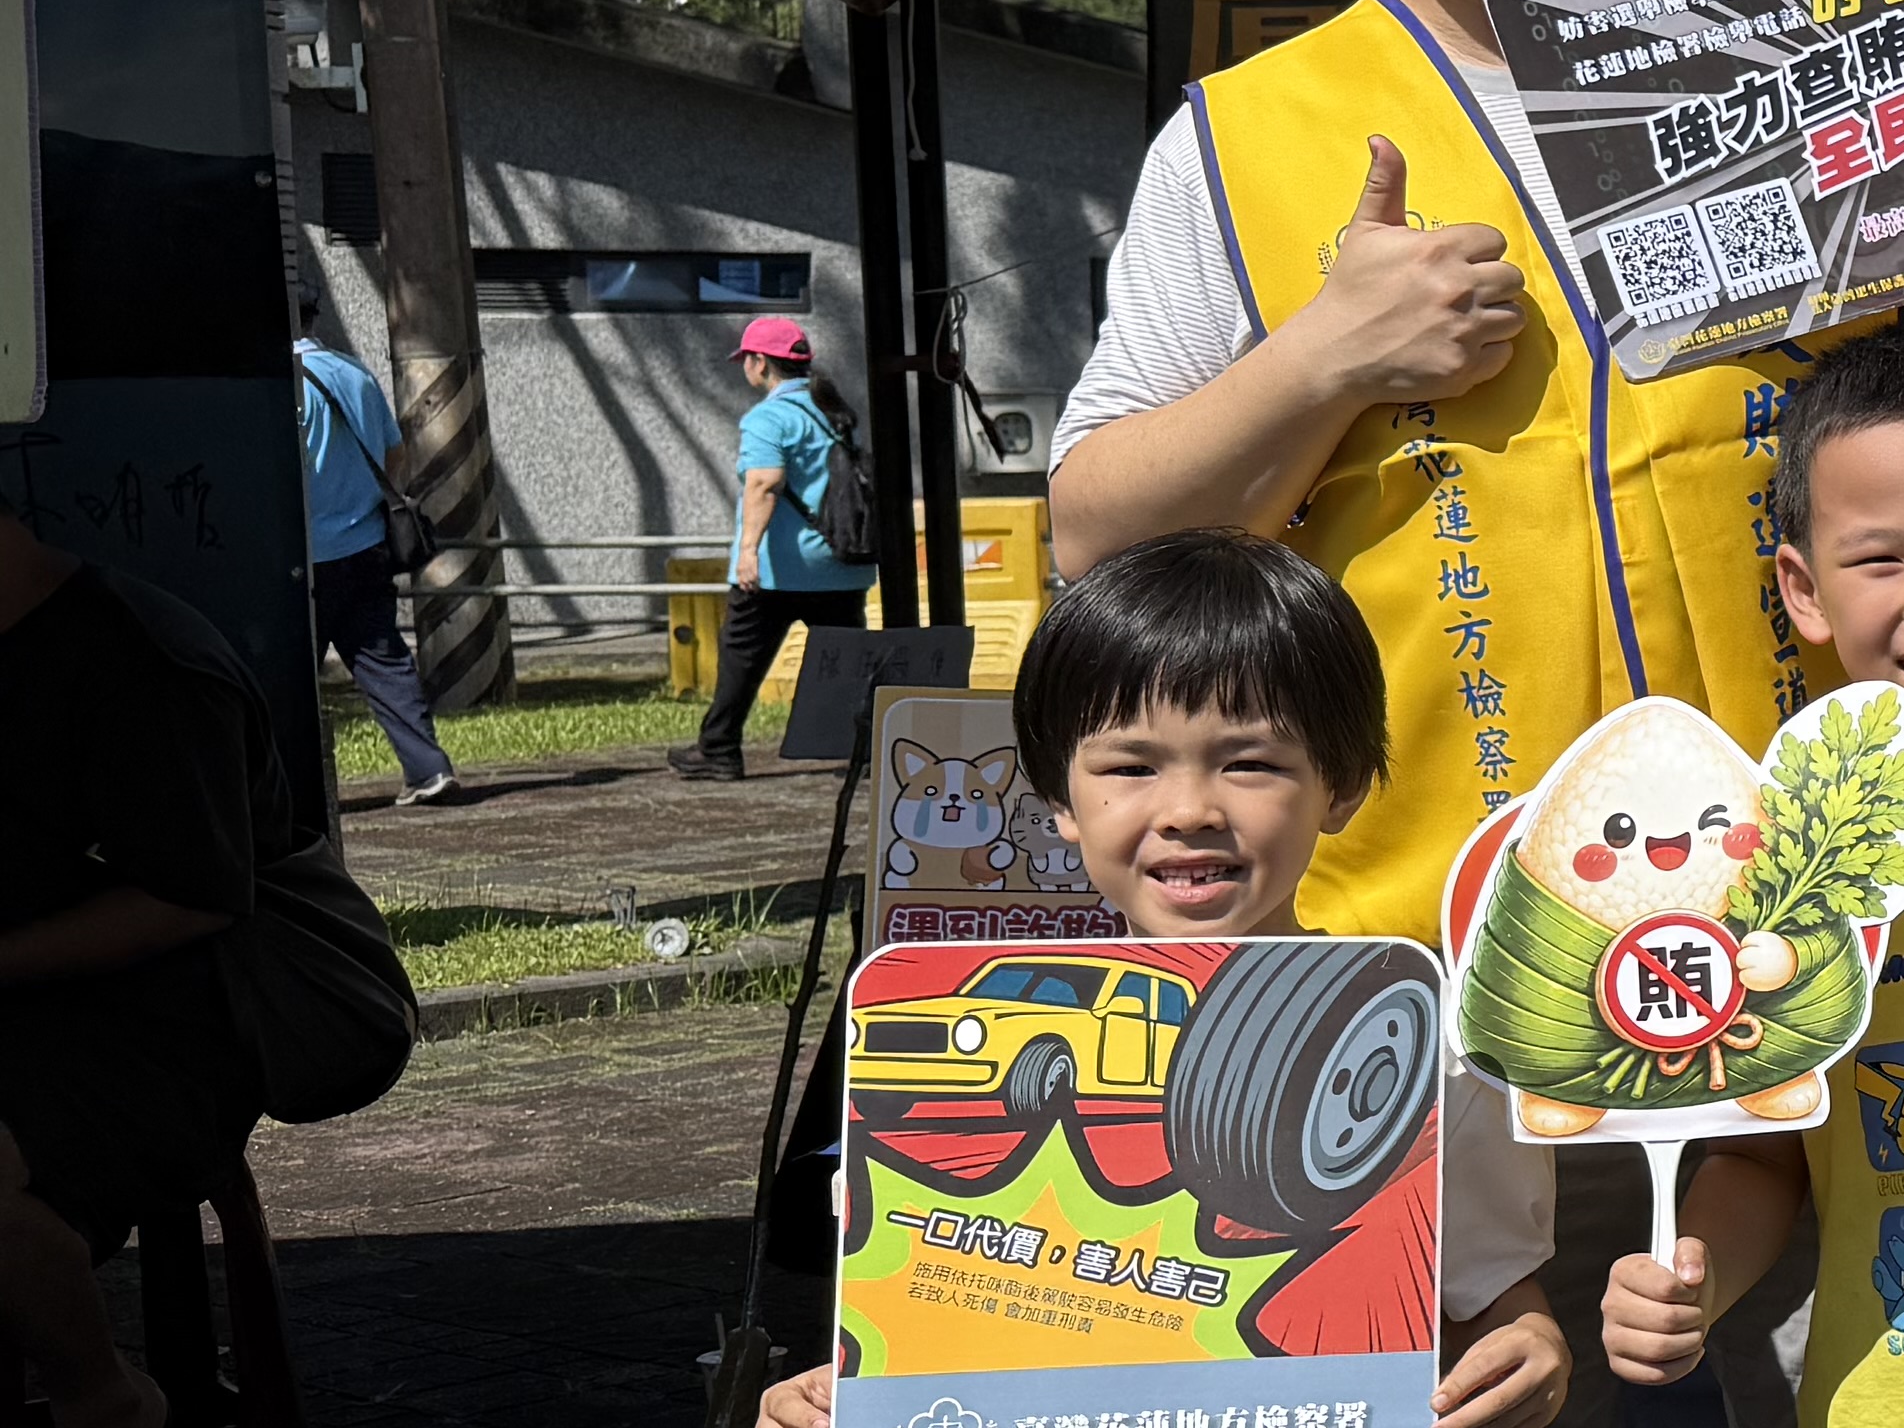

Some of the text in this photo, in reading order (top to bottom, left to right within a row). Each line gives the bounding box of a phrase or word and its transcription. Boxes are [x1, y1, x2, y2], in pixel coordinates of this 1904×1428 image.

[1572, 5, 1808, 87] 花蓮地檢署檢舉電話
[1635, 945, 1717, 1025] 賄
[887, 1208, 1231, 1307] 一口代價，害人害己
[906, 1281, 999, 1315] 若致人死傷
